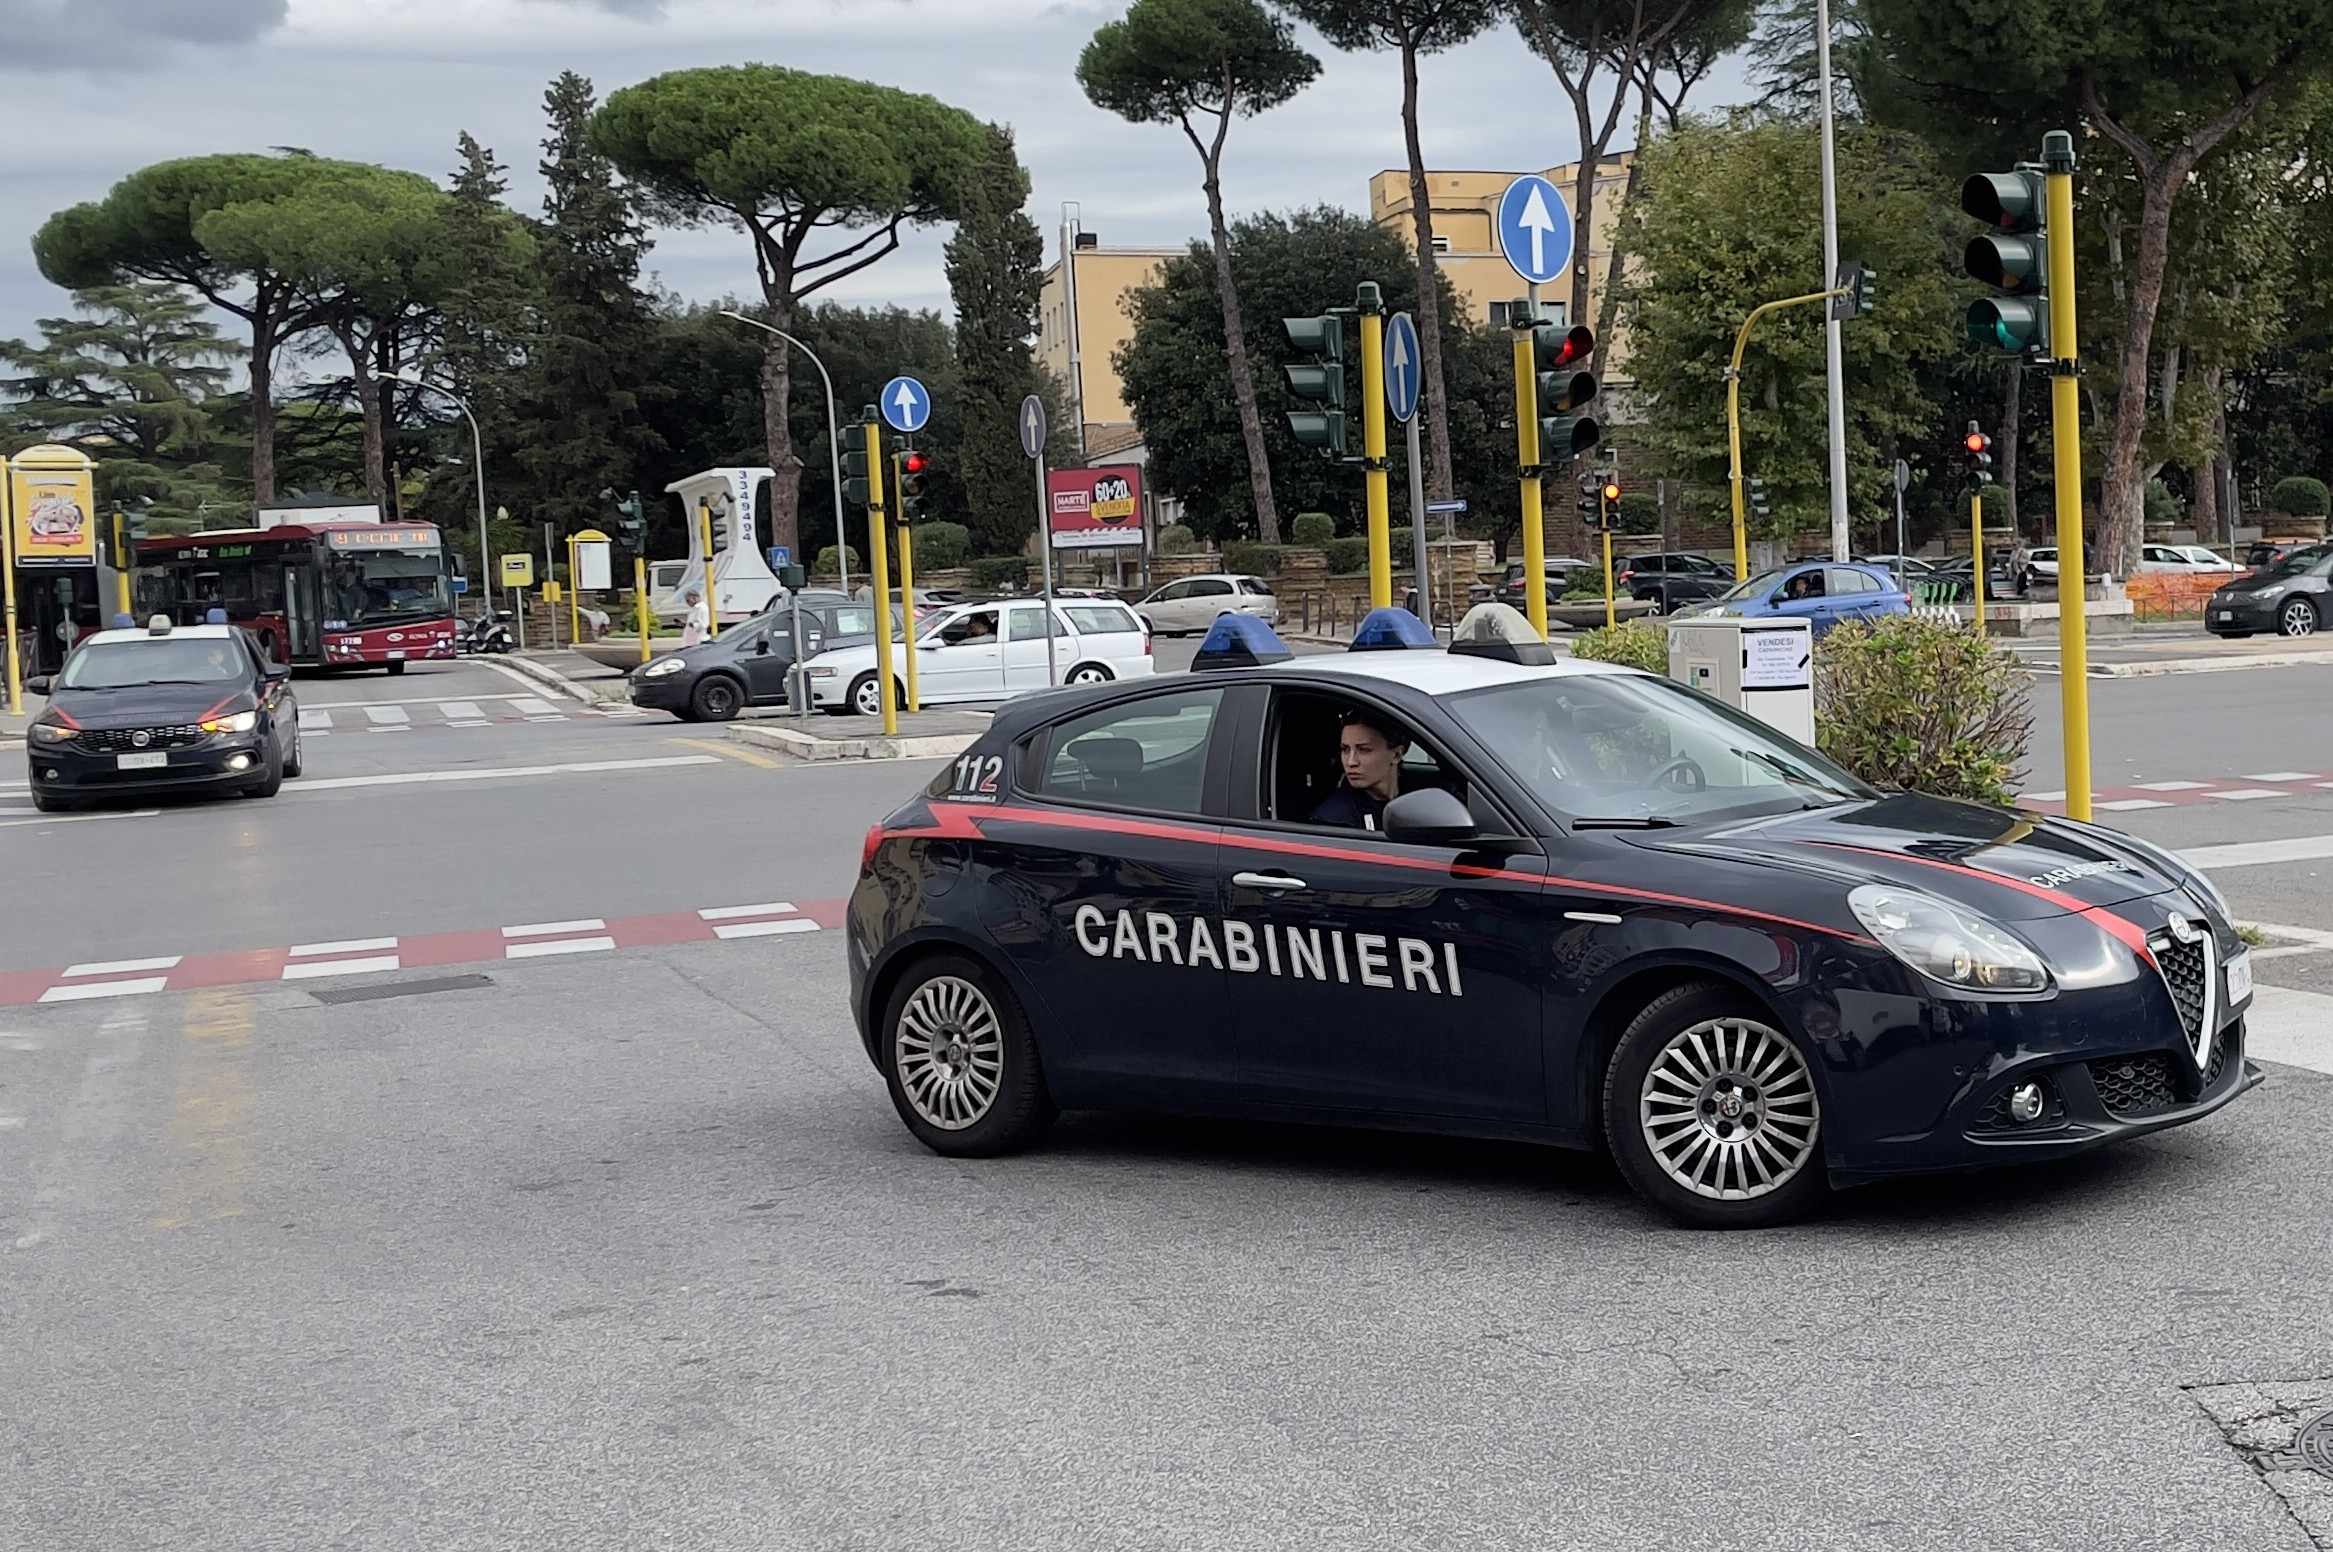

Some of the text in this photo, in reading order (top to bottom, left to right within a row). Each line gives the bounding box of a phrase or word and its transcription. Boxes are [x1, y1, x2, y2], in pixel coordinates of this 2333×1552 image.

[1757, 638, 1793, 646] VENDESI
[955, 755, 1003, 793] 112
[1075, 904, 1463, 997] CARABINIERI
